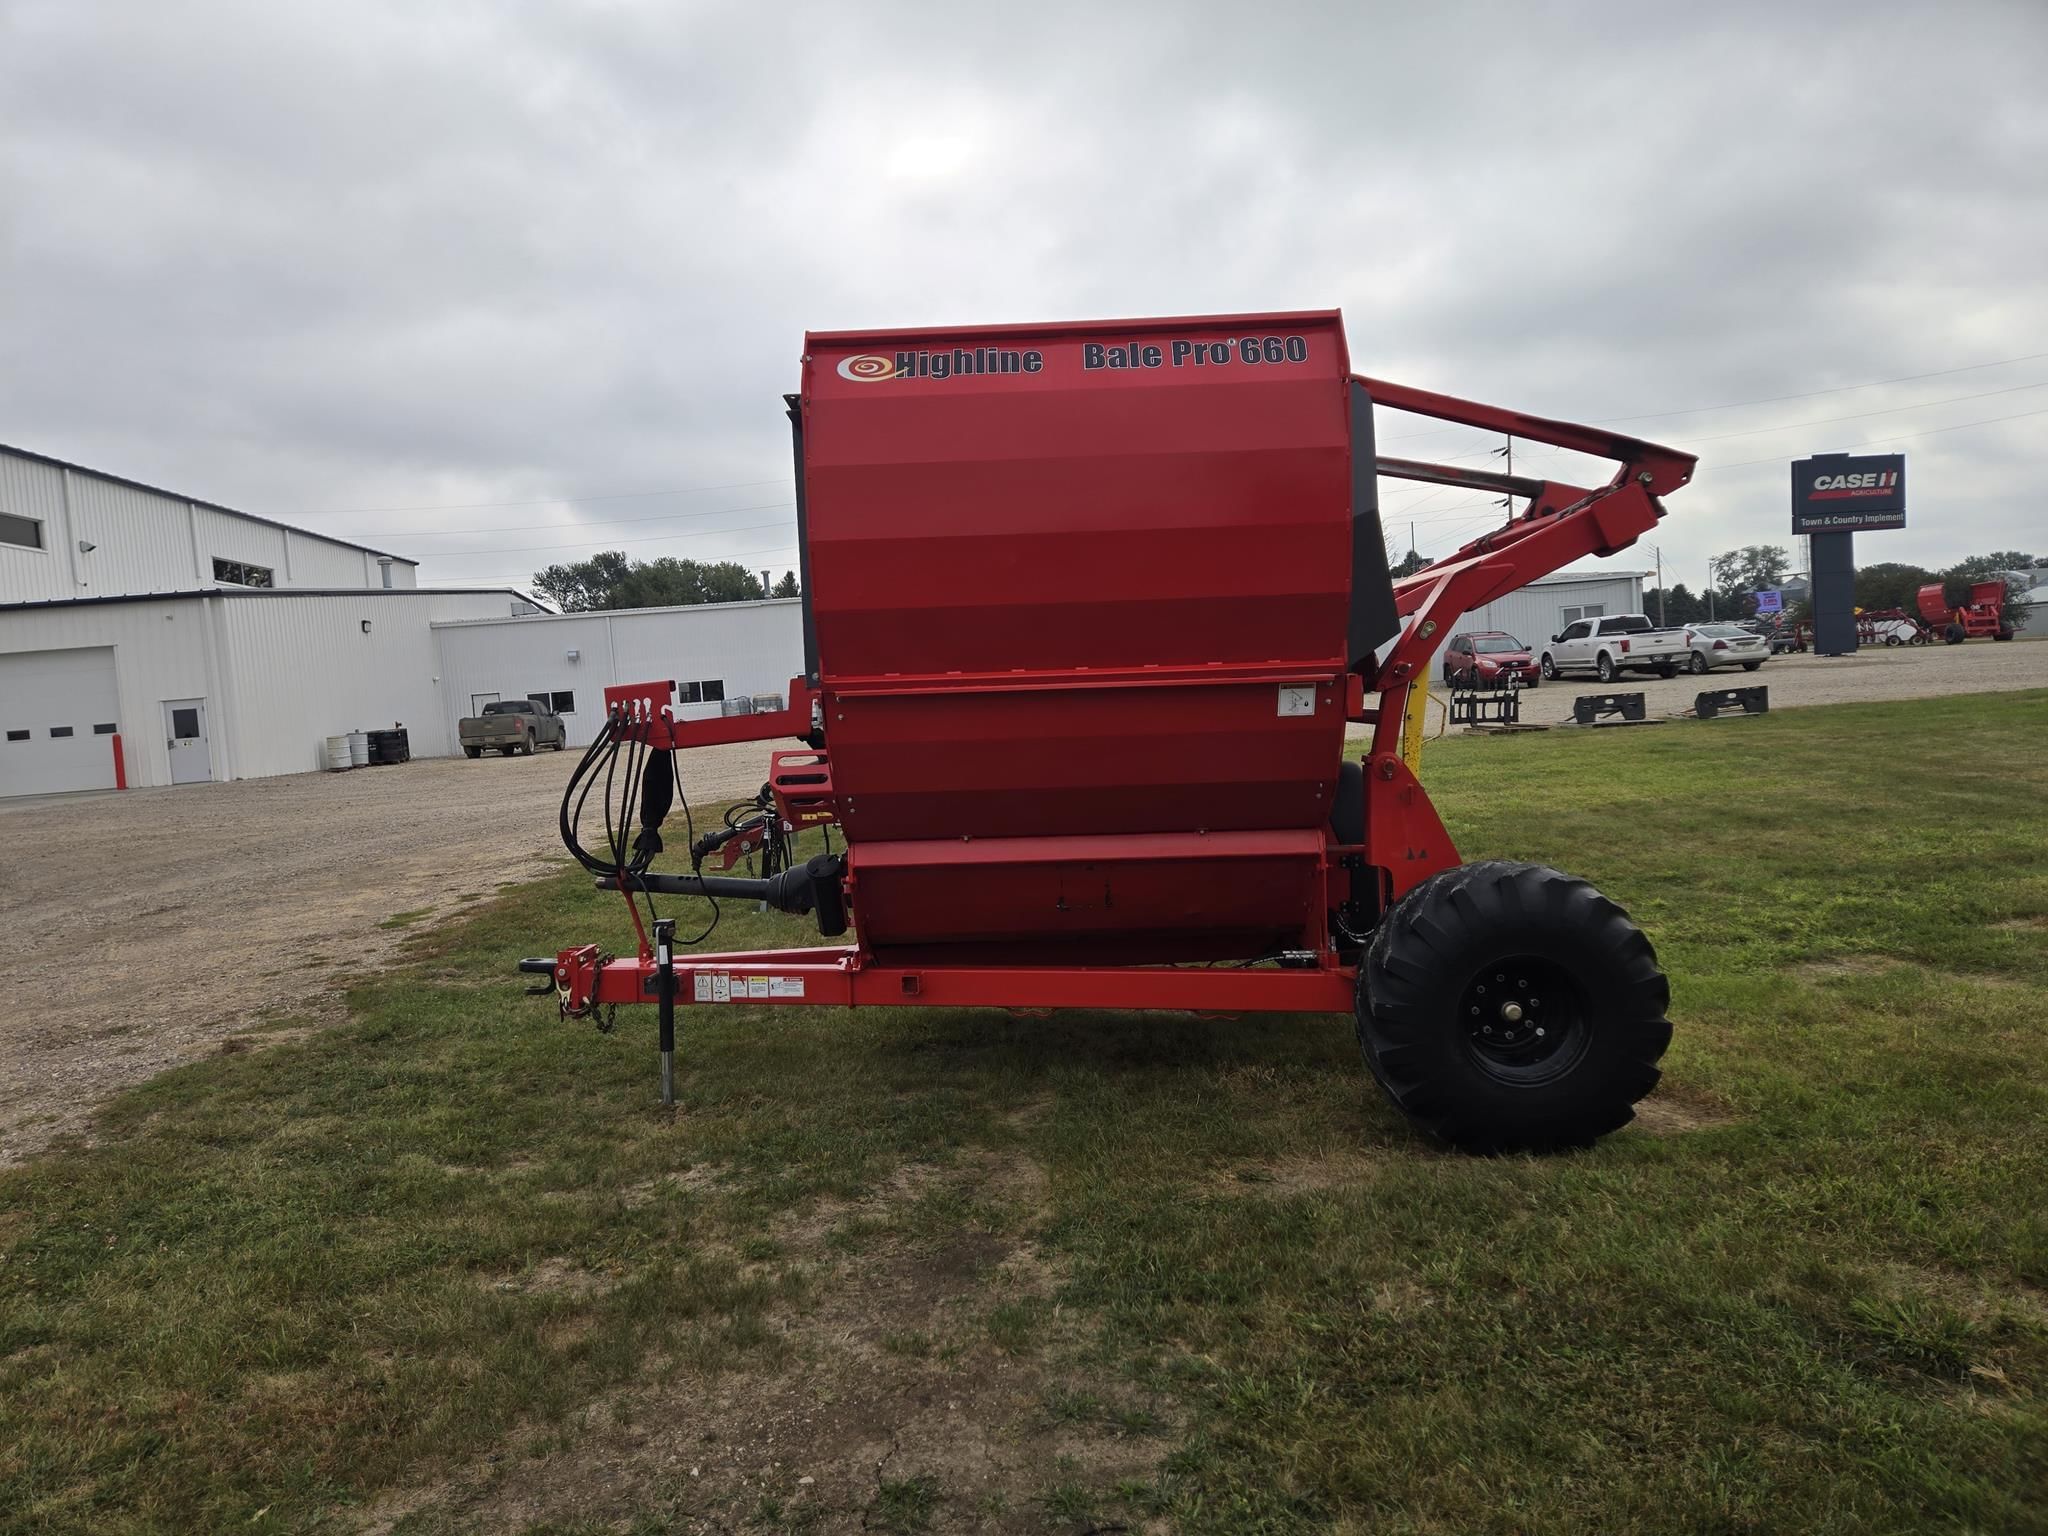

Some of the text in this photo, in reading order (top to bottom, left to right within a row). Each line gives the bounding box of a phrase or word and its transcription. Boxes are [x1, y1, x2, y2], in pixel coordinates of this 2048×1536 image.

[895, 347, 1043, 379] Highline
[1082, 341, 1163, 370] Bale
[1238, 335, 1308, 365] 660
[1814, 473, 1877, 490] CASE
[1801, 513, 1904, 526] Town & Country Implement
